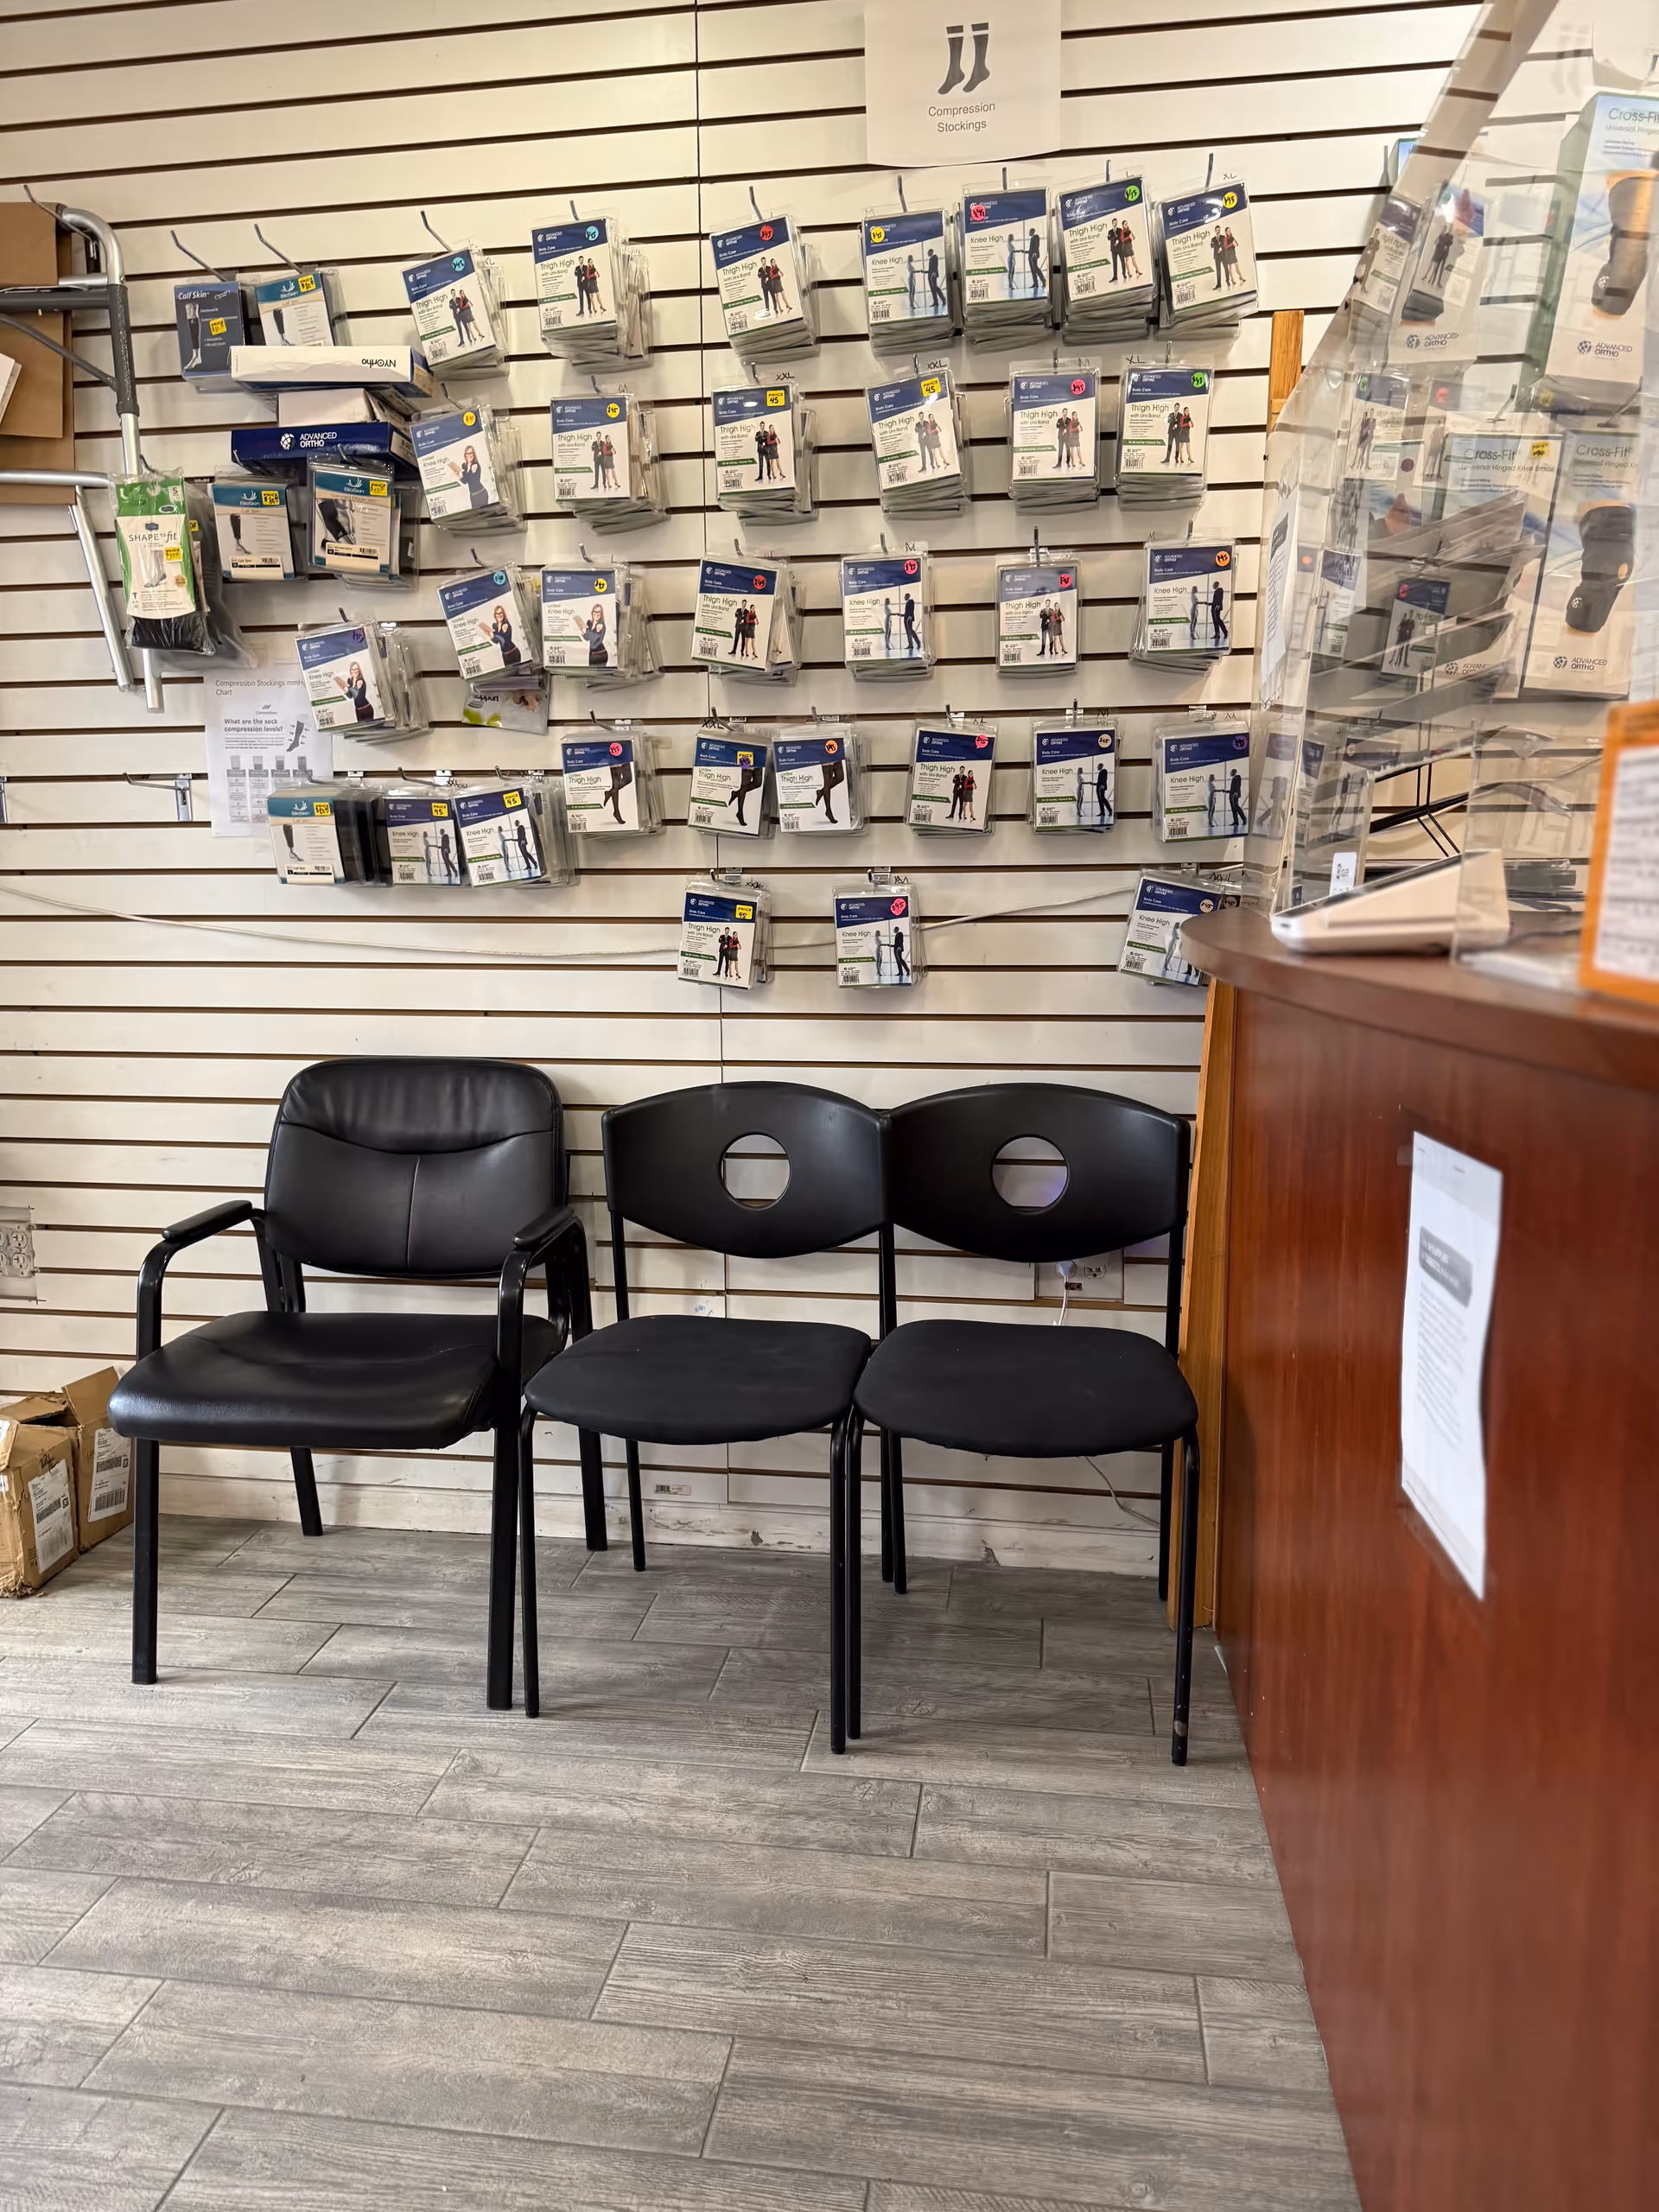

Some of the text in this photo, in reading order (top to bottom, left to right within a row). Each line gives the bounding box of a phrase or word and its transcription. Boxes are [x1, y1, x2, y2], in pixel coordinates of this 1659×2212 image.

[928, 102, 995, 118] Compression
[938, 119, 987, 133] Stockings
[1223, 172, 1237, 181] XL
[1069, 222, 1108, 238] Thigh High
[988, 234, 1004, 244] High
[1172, 230, 1211, 246] Thigh High
[540, 257, 575, 271] Thigh High
[872, 256, 904, 266] Knee High
[722, 261, 757, 276] Thigh High
[177, 290, 207, 300] Calf Skin
[415, 292, 448, 309] Thigh High
[1425, 332, 1459, 340] ADVANCED
[1595, 342, 1632, 352] ADVANCED
[1594, 348, 1619, 358] ORTHO
[361, 358, 397, 369] NYOrtho
[926, 359, 947, 370] XXL
[1125, 355, 1146, 365] XL
[776, 372, 795, 381] XXL
[923, 379, 938, 388] PRICE
[925, 385, 936, 394] 45
[1131, 403, 1169, 413] Thigh High
[1020, 410, 1058, 419] Thigh High
[878, 415, 914, 430] Thigh High
[720, 424, 756, 435] Thigh High
[300, 431, 338, 441] ADVANCED
[557, 433, 593, 443] Thigh High
[300, 439, 325, 448] ORTHO
[1576, 444, 1629, 458] Cross-Fit
[423, 457, 449, 467] Knee High
[1492, 463, 1515, 473] Hinged
[128, 533, 159, 542] SHAPE
[166, 531, 177, 543] fit
[906, 542, 916, 552] M
[1172, 586, 1188, 595] High
[702, 594, 738, 607] Thigh High
[866, 598, 880, 607] High
[1005, 601, 1041, 610] Thigh High
[563, 607, 575, 616] High
[453, 617, 479, 630] Knee High
[1571, 663, 1595, 671] ORTHO
[1572, 658, 1608, 666] ADVANCED
[257, 679, 286, 688] Stockings
[702, 718, 724, 729] XXL
[920, 763, 956, 775] Thigh High
[1058, 766, 1073, 776] High
[698, 770, 716, 779] Thigh
[717, 772, 731, 782] High
[780, 773, 814, 783] Thigh High
[1170, 775, 1205, 785] Knee High
[506, 798, 518, 806] 45
[406, 830, 420, 838] High
[466, 827, 494, 837] Knee High
[1139, 914, 1171, 927] Knee High
[688, 923, 721, 935] Thigh High
